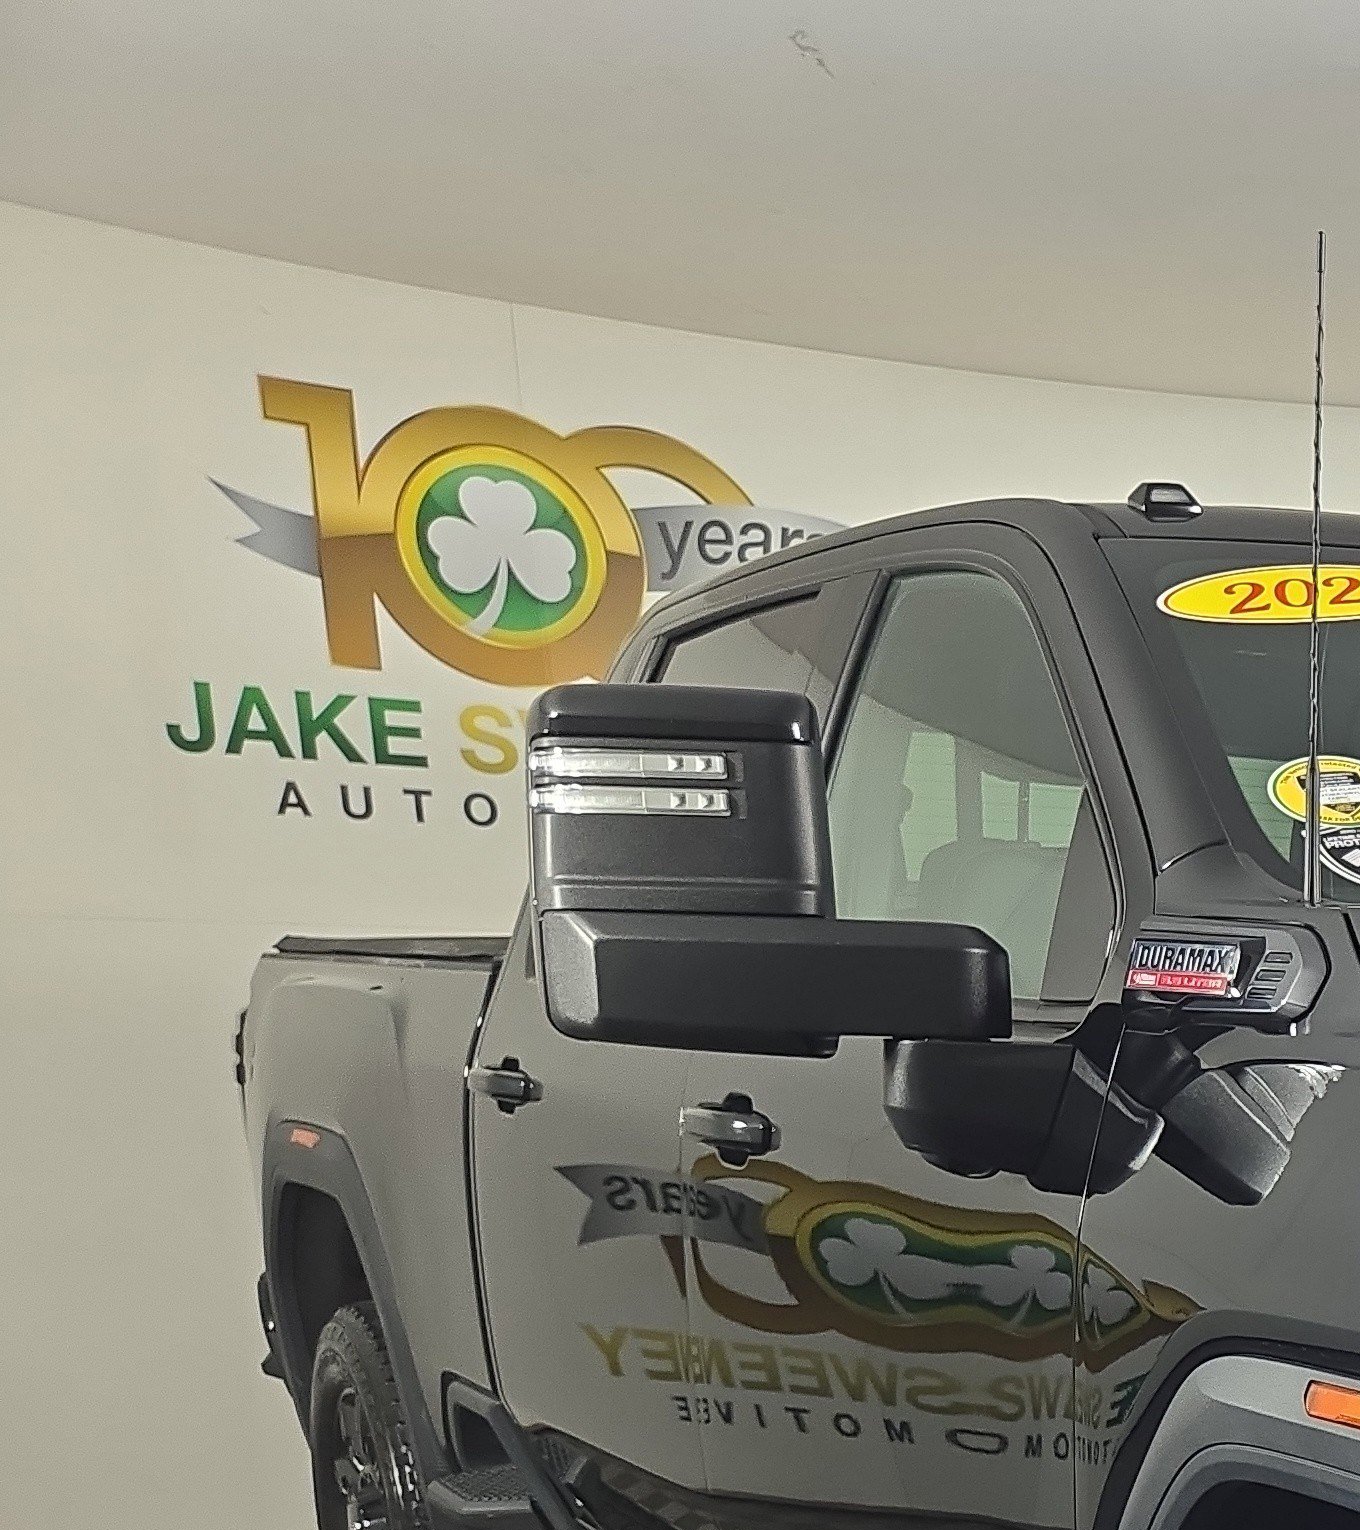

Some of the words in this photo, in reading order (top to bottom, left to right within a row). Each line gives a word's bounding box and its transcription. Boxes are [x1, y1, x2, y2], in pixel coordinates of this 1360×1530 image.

[657, 520, 823, 580] year
[166, 681, 429, 770] JAKE
[1138, 944, 1230, 974] DURAMAX
